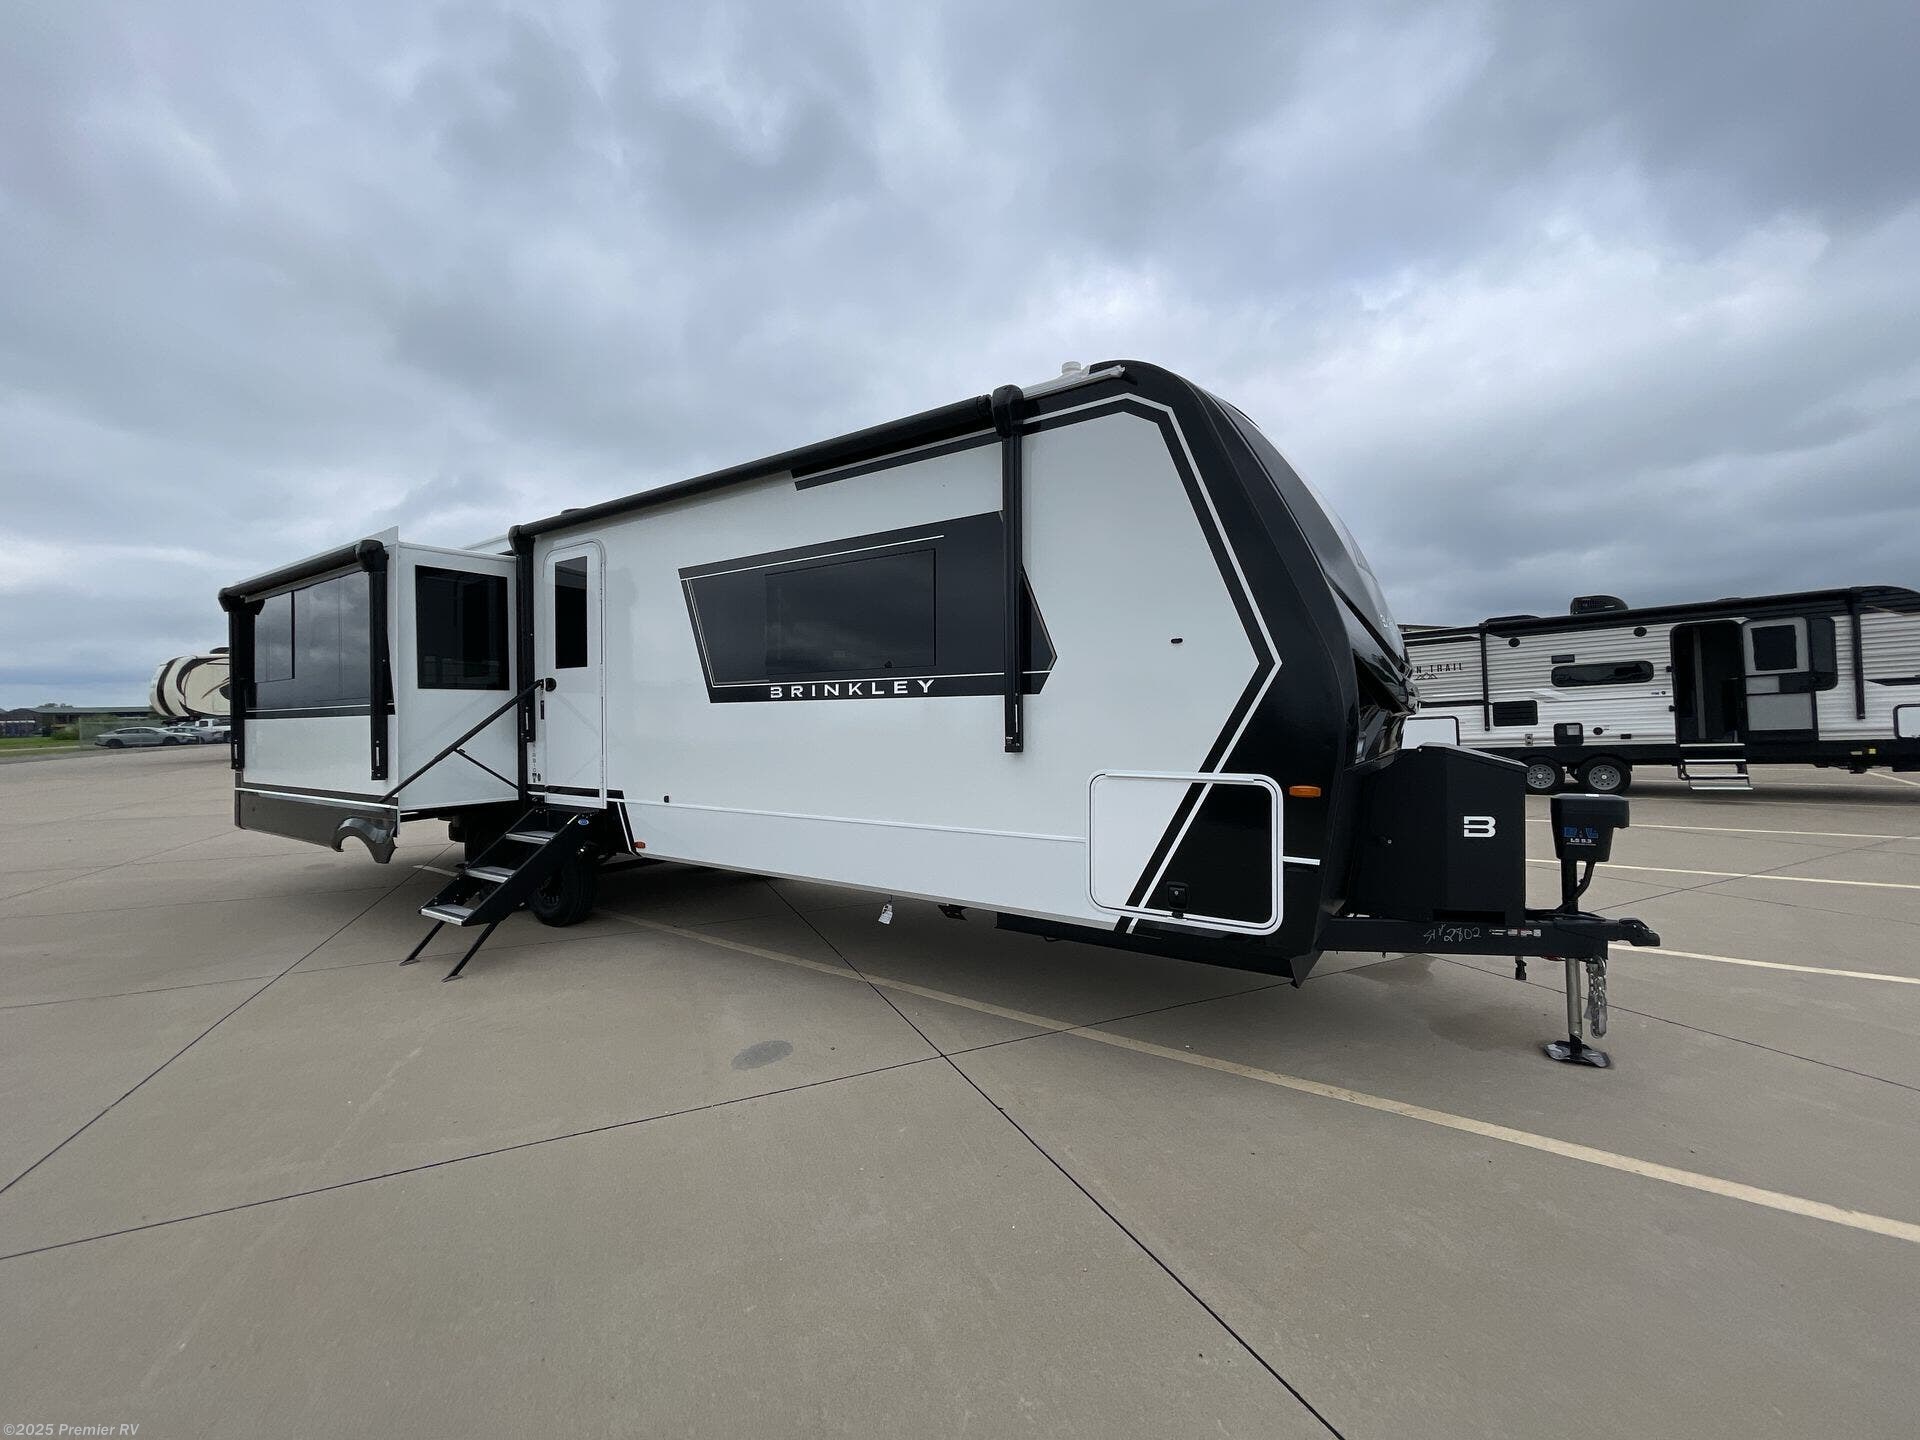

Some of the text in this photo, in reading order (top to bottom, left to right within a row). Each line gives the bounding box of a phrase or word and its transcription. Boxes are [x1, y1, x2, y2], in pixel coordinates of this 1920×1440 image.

[1429, 662, 1463, 672] TRAIL
[770, 679, 935, 698] BRINKLEY
[1464, 816, 1496, 837] B
